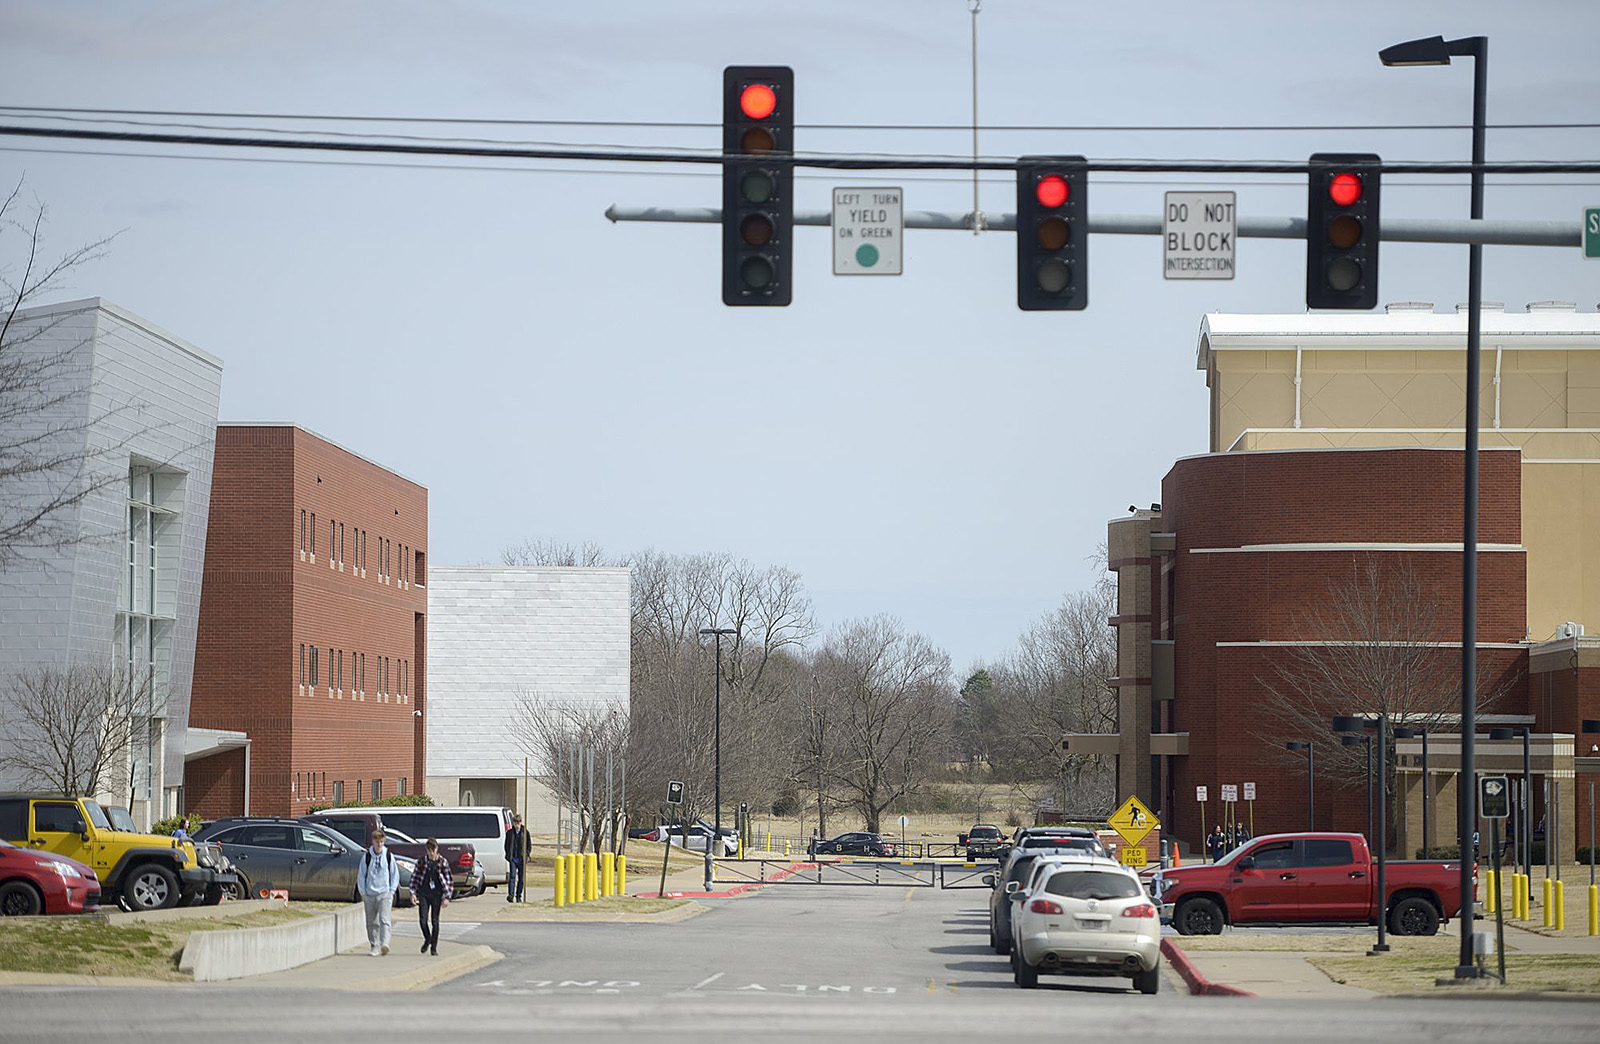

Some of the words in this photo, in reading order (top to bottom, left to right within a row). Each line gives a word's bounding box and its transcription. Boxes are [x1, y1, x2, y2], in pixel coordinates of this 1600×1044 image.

[837, 194, 860, 204] LEFT
[873, 194, 899, 204] TURN
[849, 209, 887, 223] YIELD
[1169, 203, 1188, 222] DO
[1204, 203, 1234, 222] NOT
[1589, 213, 1600, 234] S
[839, 227, 853, 238] ON
[861, 227, 893, 238] GREEN
[1168, 232, 1231, 251] BLOCK
[1167, 257, 1233, 271] INTERSECTION
[863, 845, 870, 853] H
